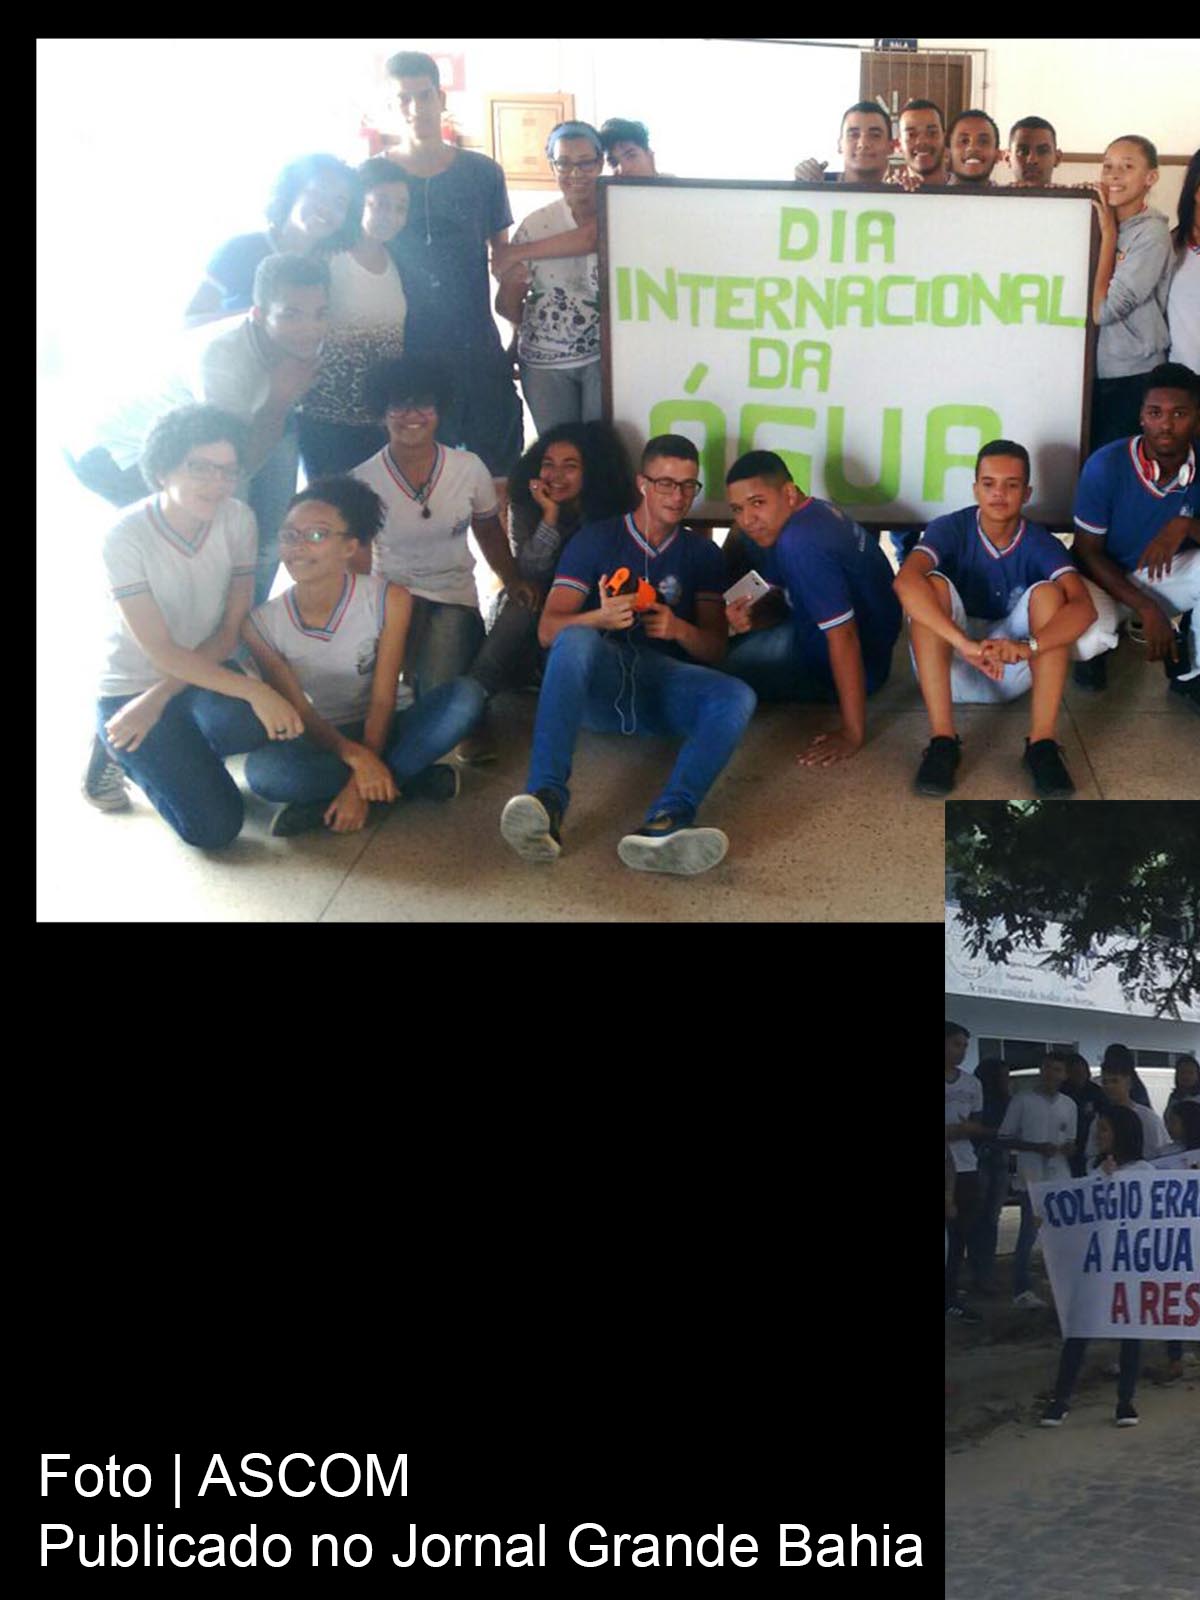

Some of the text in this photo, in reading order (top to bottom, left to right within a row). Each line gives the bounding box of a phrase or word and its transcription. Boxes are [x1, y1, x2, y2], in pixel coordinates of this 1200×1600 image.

[779, 206, 895, 263] DIA
[615, 266, 1087, 330] INTERNACIONAL
[748, 337, 832, 393] DA
[649, 362, 1001, 506] ÁGUA
[1044, 1177, 1142, 1227] COLÉGIO
[1083, 1230, 1102, 1273] A
[1112, 1222, 1194, 1273] ÁGUA
[1111, 1281, 1131, 1325] A
